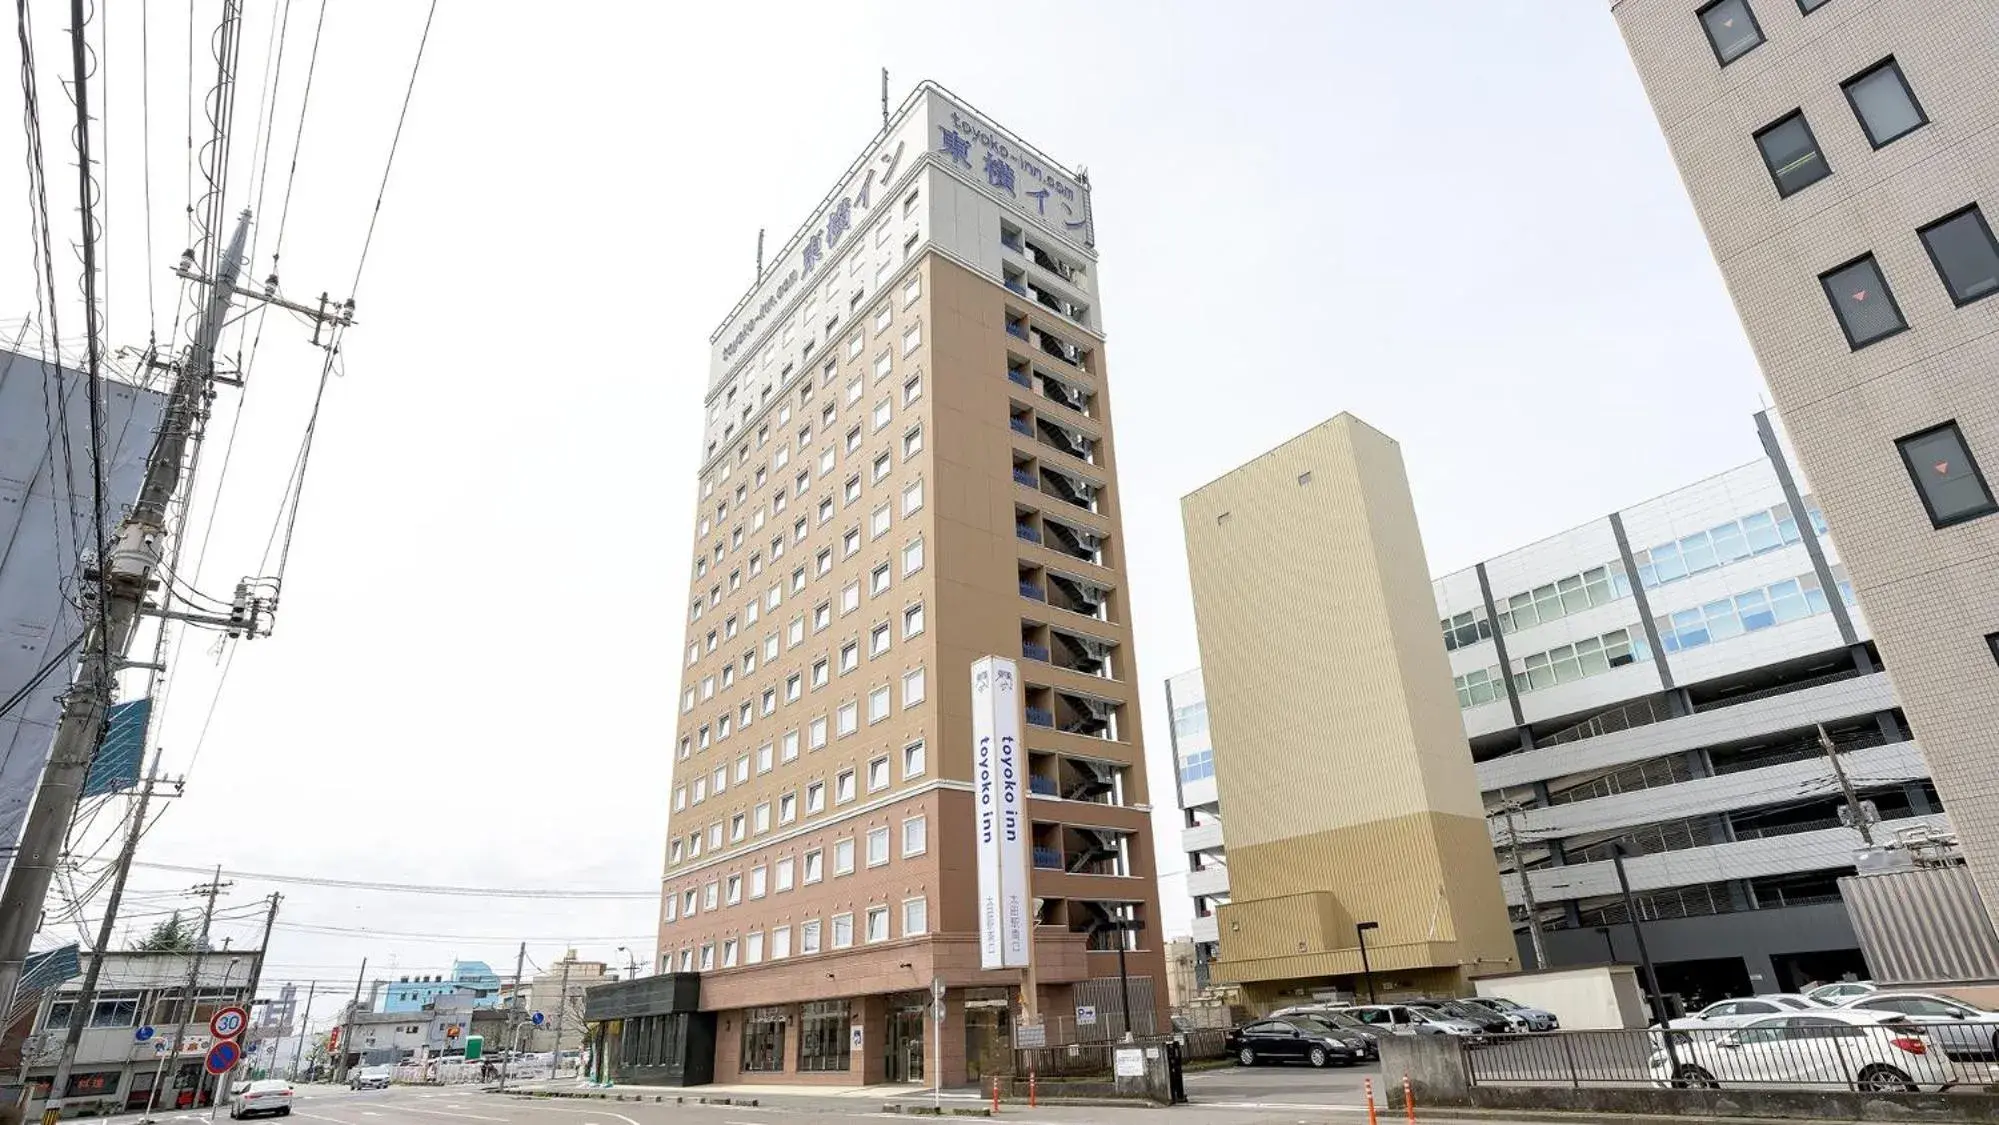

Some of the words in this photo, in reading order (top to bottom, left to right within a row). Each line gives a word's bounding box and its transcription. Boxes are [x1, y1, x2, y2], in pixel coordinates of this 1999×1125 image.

[937, 124, 1087, 231] 東横イン
[950, 111, 1075, 201] toyoko-inn.com
[979, 735, 992, 805] toyoko
[1001, 735, 1017, 803] toyoko
[983, 811, 994, 843] inn
[1005, 810, 1018, 841] inn
[218, 1015, 239, 1031] 30
